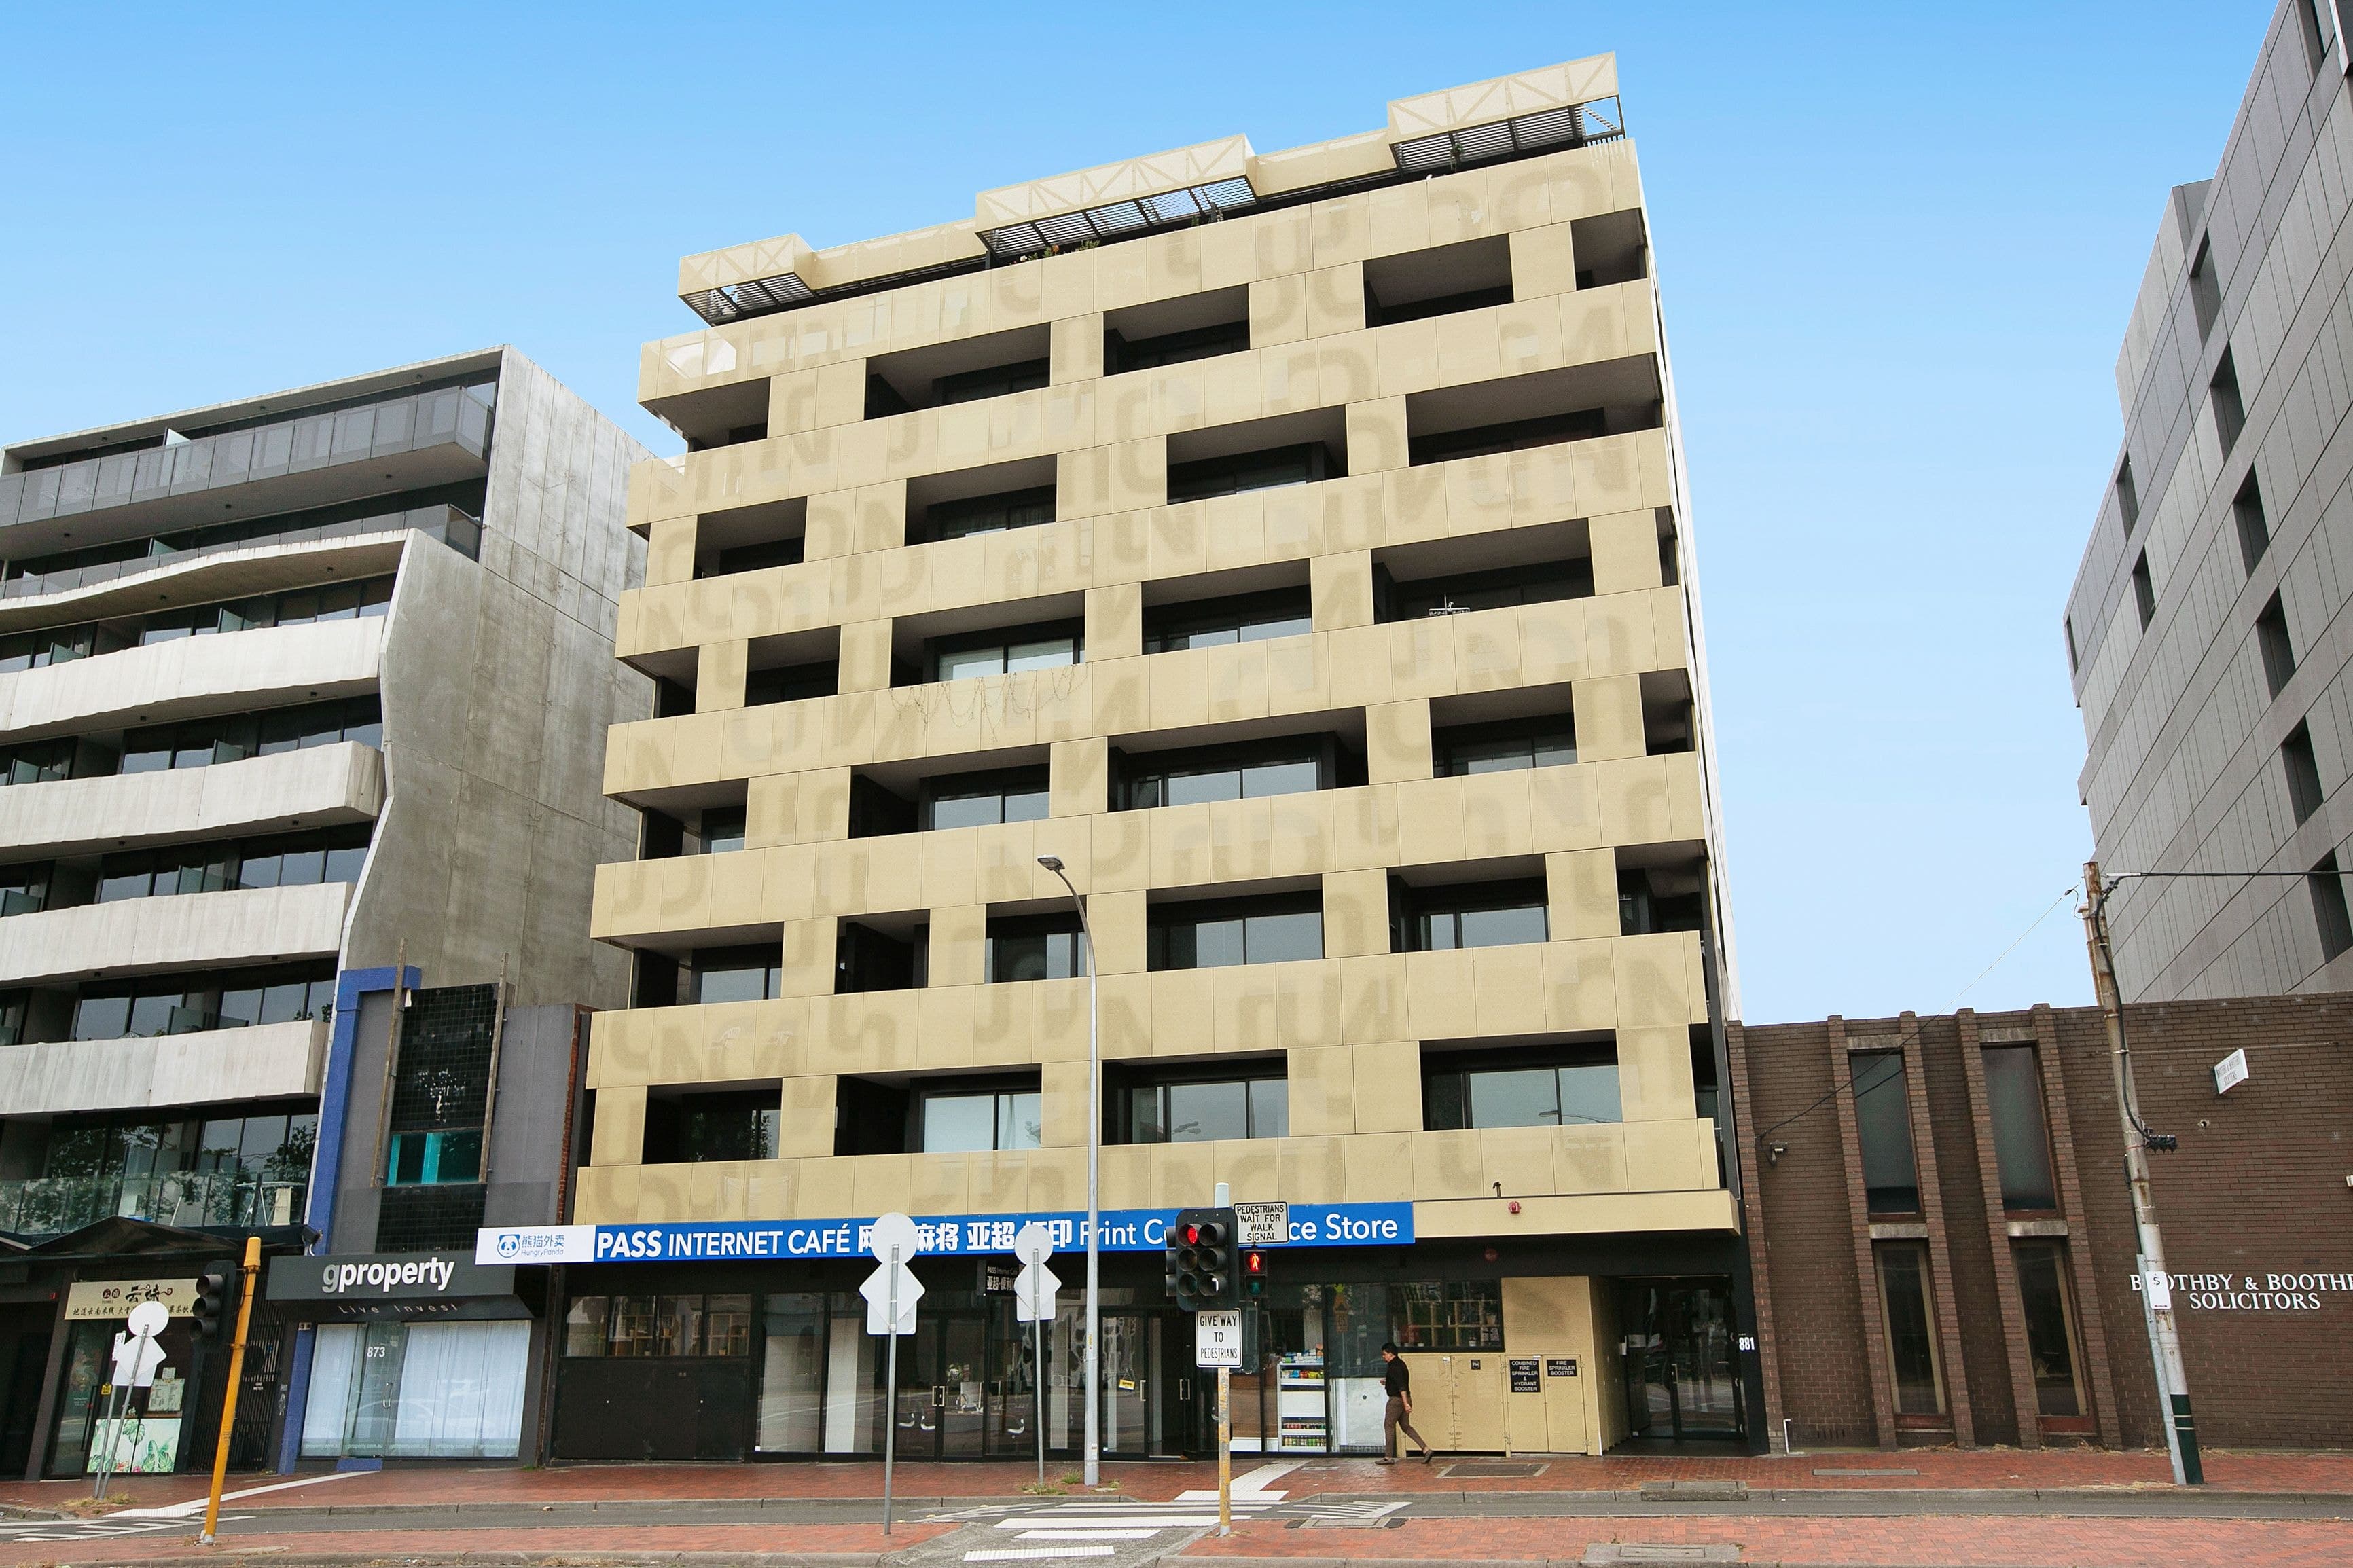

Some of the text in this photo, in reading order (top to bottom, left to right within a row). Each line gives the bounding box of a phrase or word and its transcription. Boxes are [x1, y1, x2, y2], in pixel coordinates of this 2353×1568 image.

[1236, 1205, 1285, 1214] PEDESTRIANS
[1240, 1214, 1281, 1223] WAIT FOR
[1250, 1223, 1274, 1232] WALK
[521, 1234, 565, 1248] 熊猫外卖
[596, 1230, 663, 1258] PASS
[668, 1230, 783, 1256] INTERNET
[787, 1222, 850, 1254] CAFÉ
[966, 1221, 1015, 1251] 亚超
[1079, 1220, 1137, 1246] Print
[1325, 1213, 1398, 1241] Store
[1246, 1232, 1278, 1241] SIGNAL
[520, 1248, 564, 1257] HungryPanda
[321, 1256, 456, 1294] gproperty
[2129, 1273, 2233, 1291] BTHBY
[2244, 1276, 2258, 1290] &
[2189, 1292, 2322, 1310] SOLICITORS
[338, 1303, 459, 1314] Live Invest
[1200, 1315, 1237, 1326] GIVE WAY
[1214, 1332, 1223, 1343] TO
[1739, 1336, 1755, 1351] 881
[367, 1346, 386, 1358] 873
[1200, 1347, 1238, 1359] PEDESTRIANS
